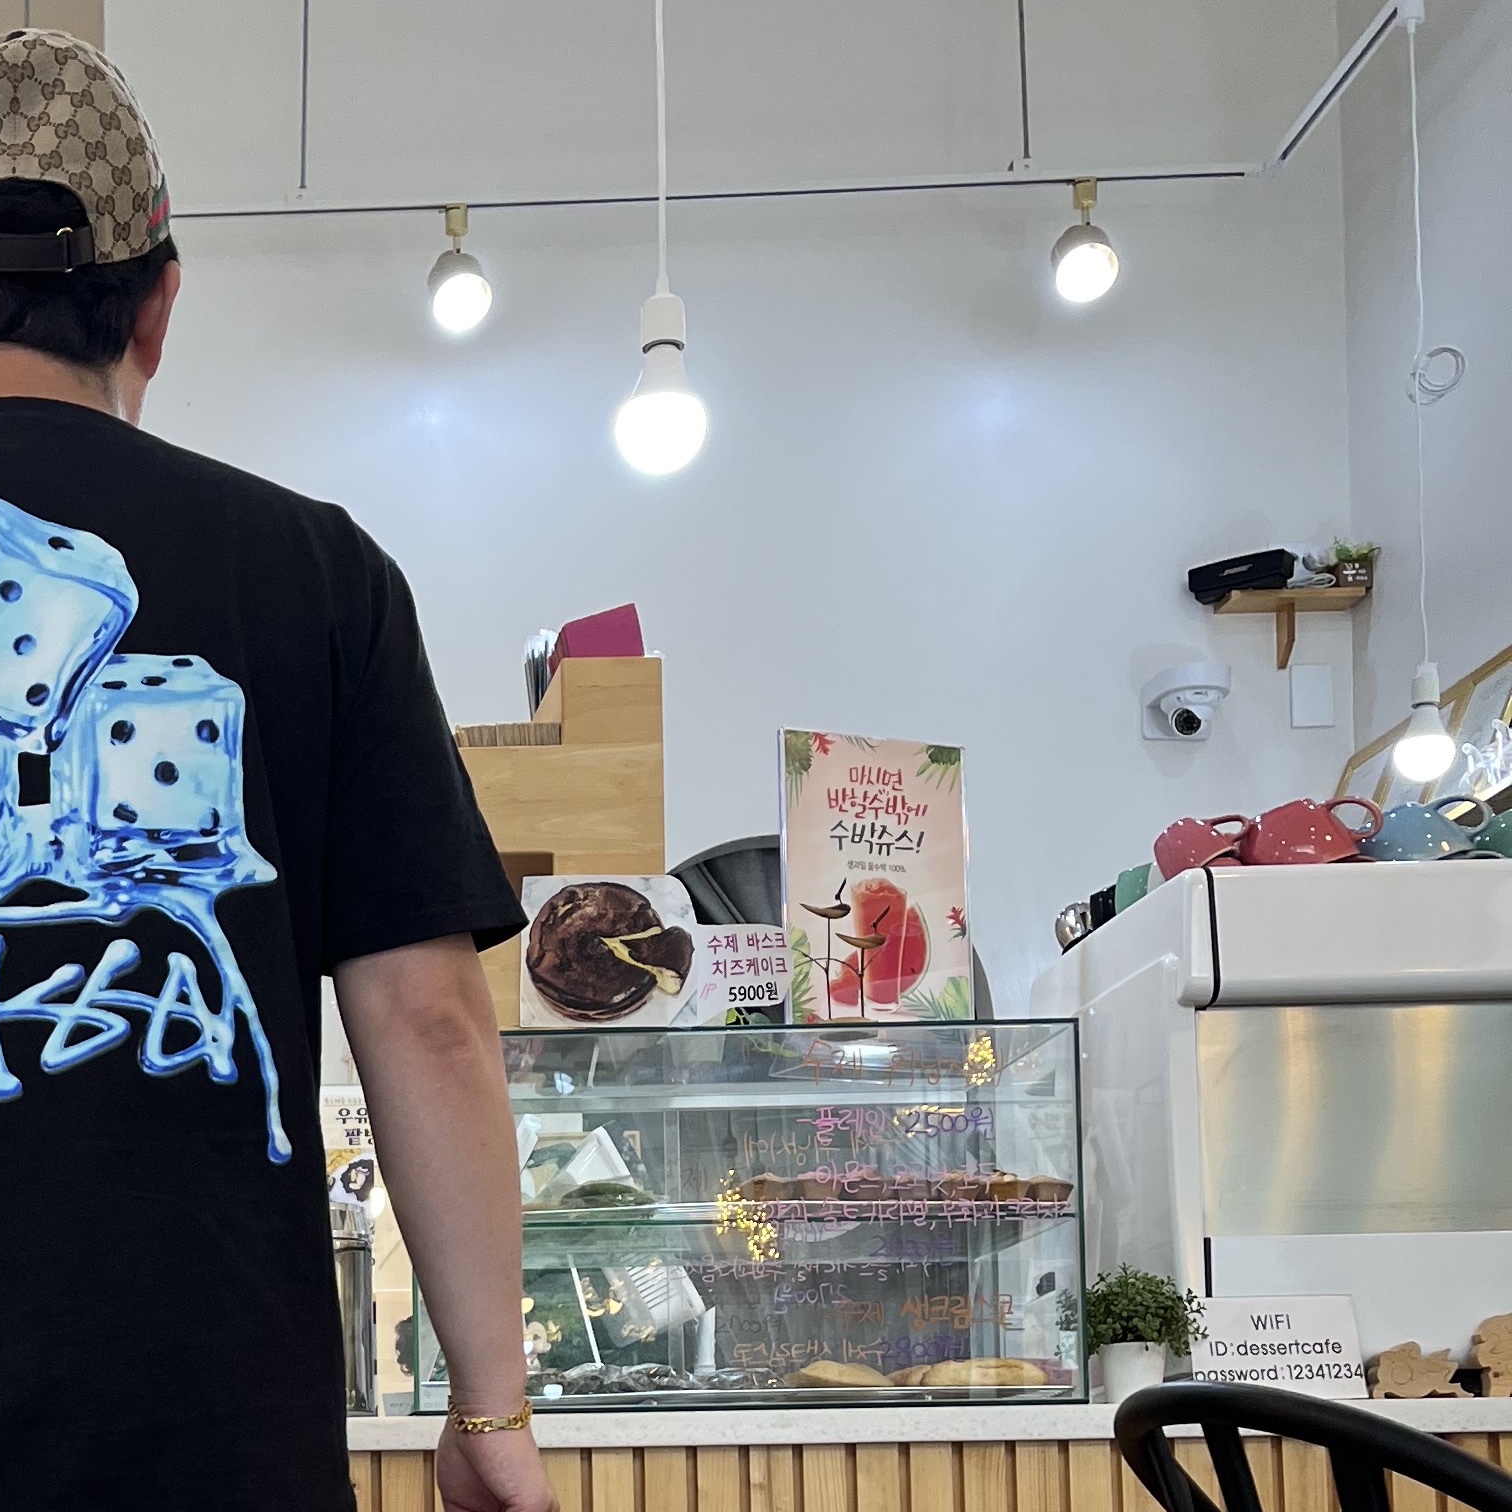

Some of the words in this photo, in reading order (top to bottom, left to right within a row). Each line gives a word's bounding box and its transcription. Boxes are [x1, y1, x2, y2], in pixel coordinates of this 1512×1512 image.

[848, 764, 904, 792] 마시면
[829, 819, 926, 857] 수박쥬스!
[706, 932, 739, 955] 수제
[746, 931, 788, 952] 바스크
[711, 955, 788, 979] 치즈케이크
[728, 980, 779, 1002] 5900원
[1209, 1338, 1343, 1359] ID:dessertcafe
